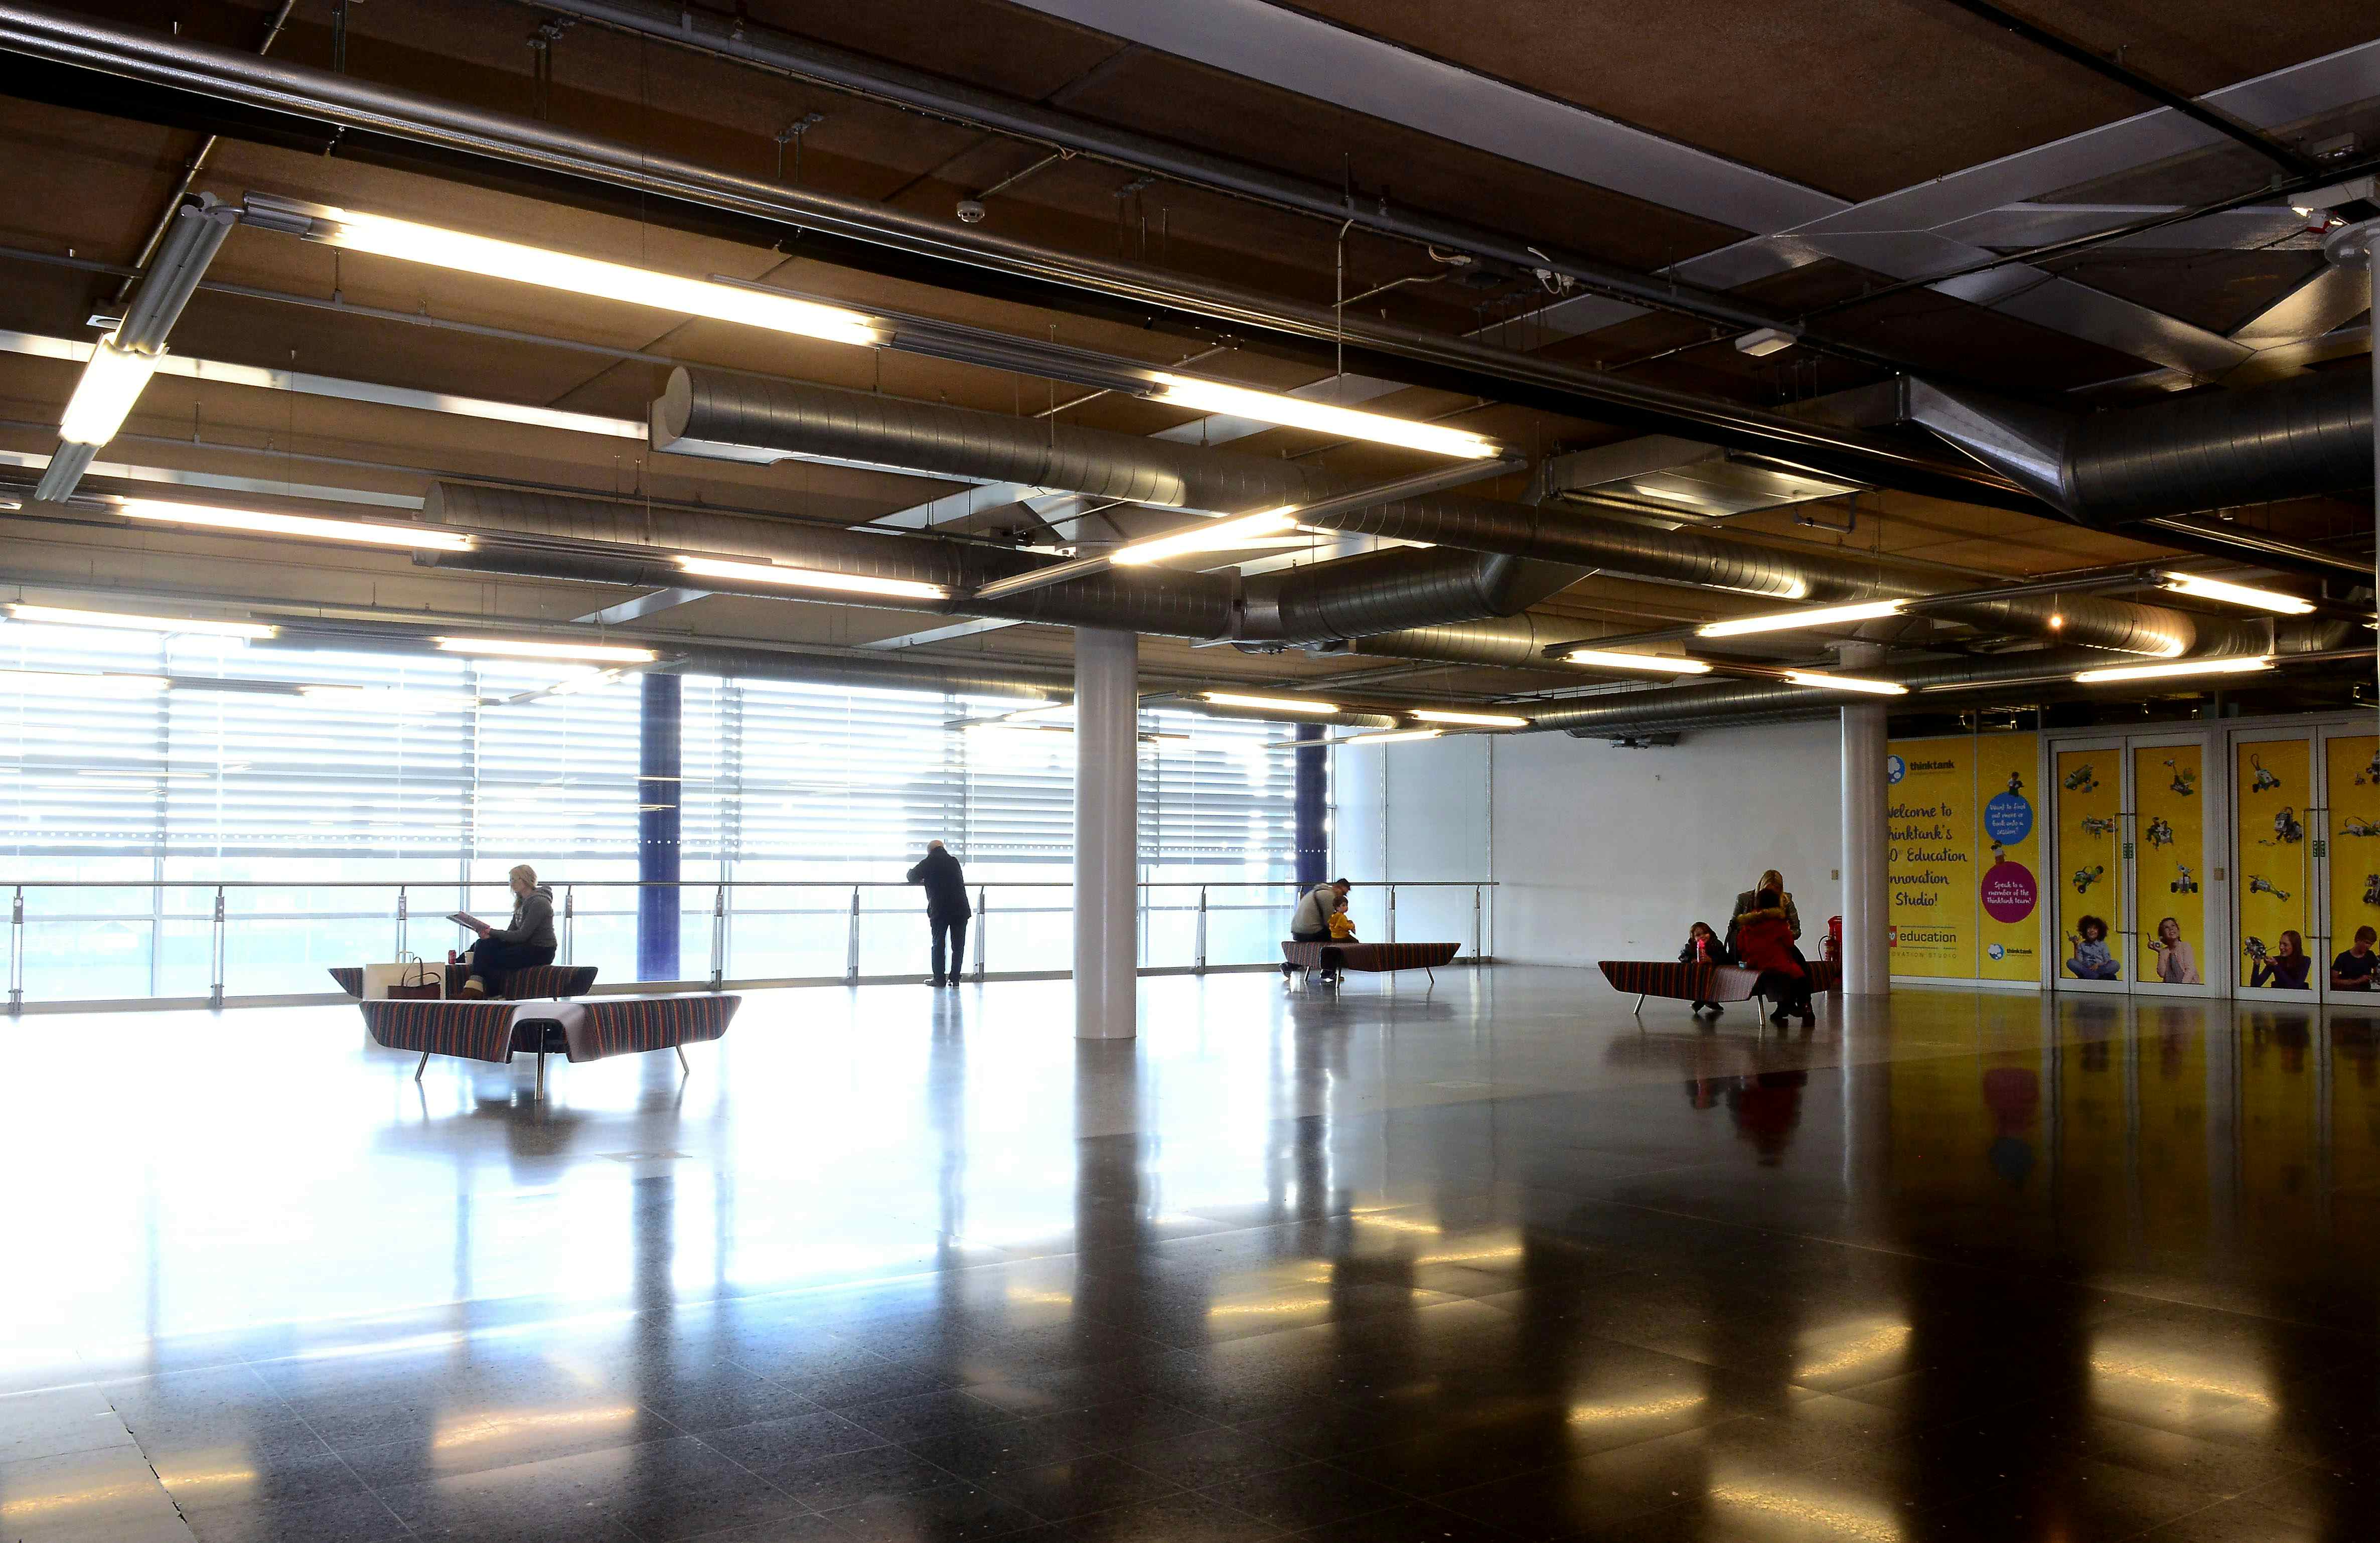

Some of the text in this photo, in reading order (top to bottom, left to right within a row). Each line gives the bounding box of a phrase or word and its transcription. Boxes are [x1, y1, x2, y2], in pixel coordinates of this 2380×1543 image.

[1910, 759, 1955, 770] thinktank
[1941, 802, 1952, 817] to
[1888, 824, 1953, 841] hinktank's
[1907, 847, 1968, 862] Education
[1889, 869, 1951, 885] nnovation
[1995, 881, 2012, 890] Speak
[1895, 891, 1938, 906] Studio!
[1899, 931, 1956, 943] education
